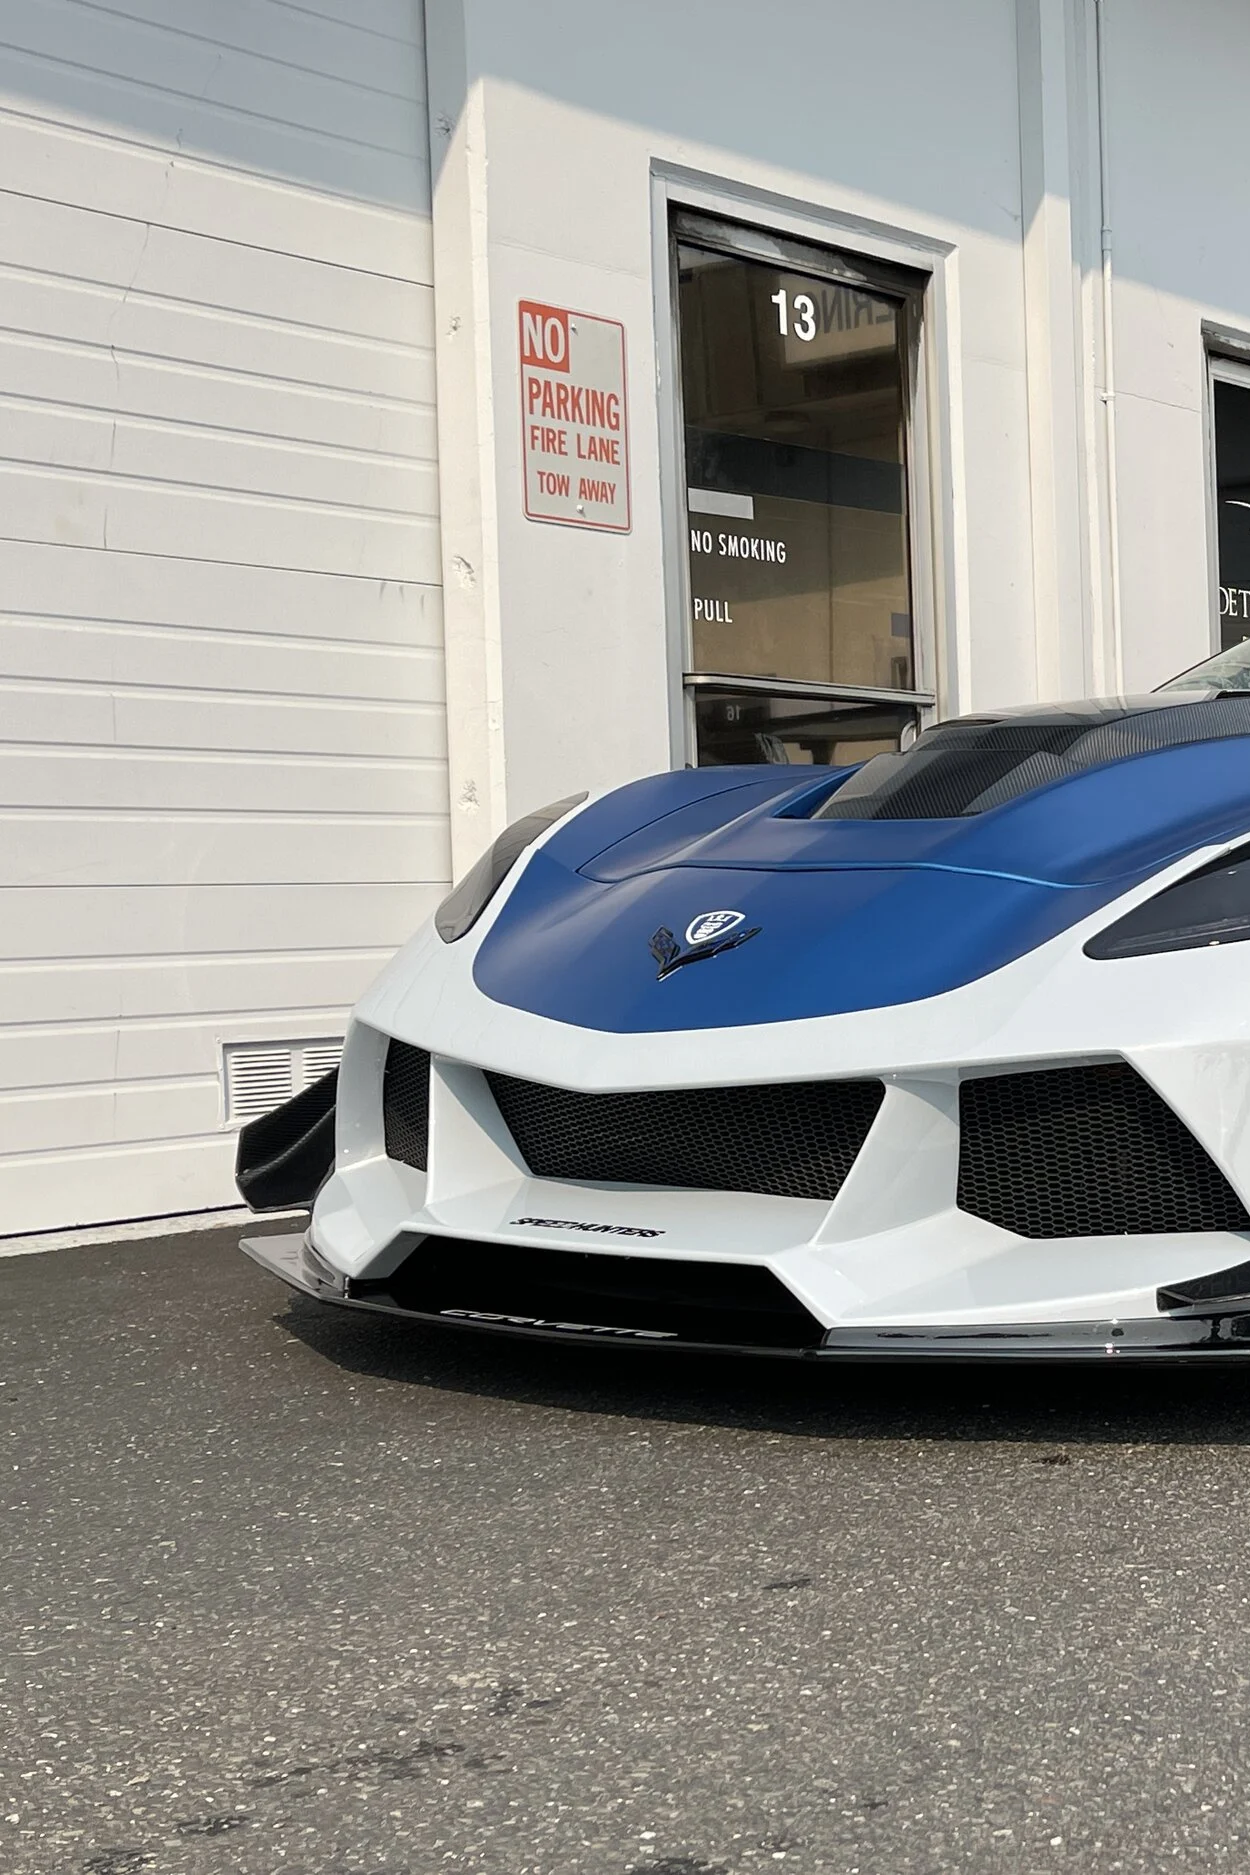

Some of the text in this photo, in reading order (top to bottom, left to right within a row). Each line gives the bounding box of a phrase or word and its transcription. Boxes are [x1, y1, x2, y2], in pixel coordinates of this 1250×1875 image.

[771, 288, 817, 342] 13
[522, 311, 566, 364] NO
[528, 376, 620, 431] PARKING
[530, 425, 621, 466] FIRE LANE
[537, 471, 617, 505] TOW AWAY
[690, 530, 786, 564] NO SMOKING
[694, 598, 733, 624] PULL
[440, 1309, 679, 1338] CORVETTE
